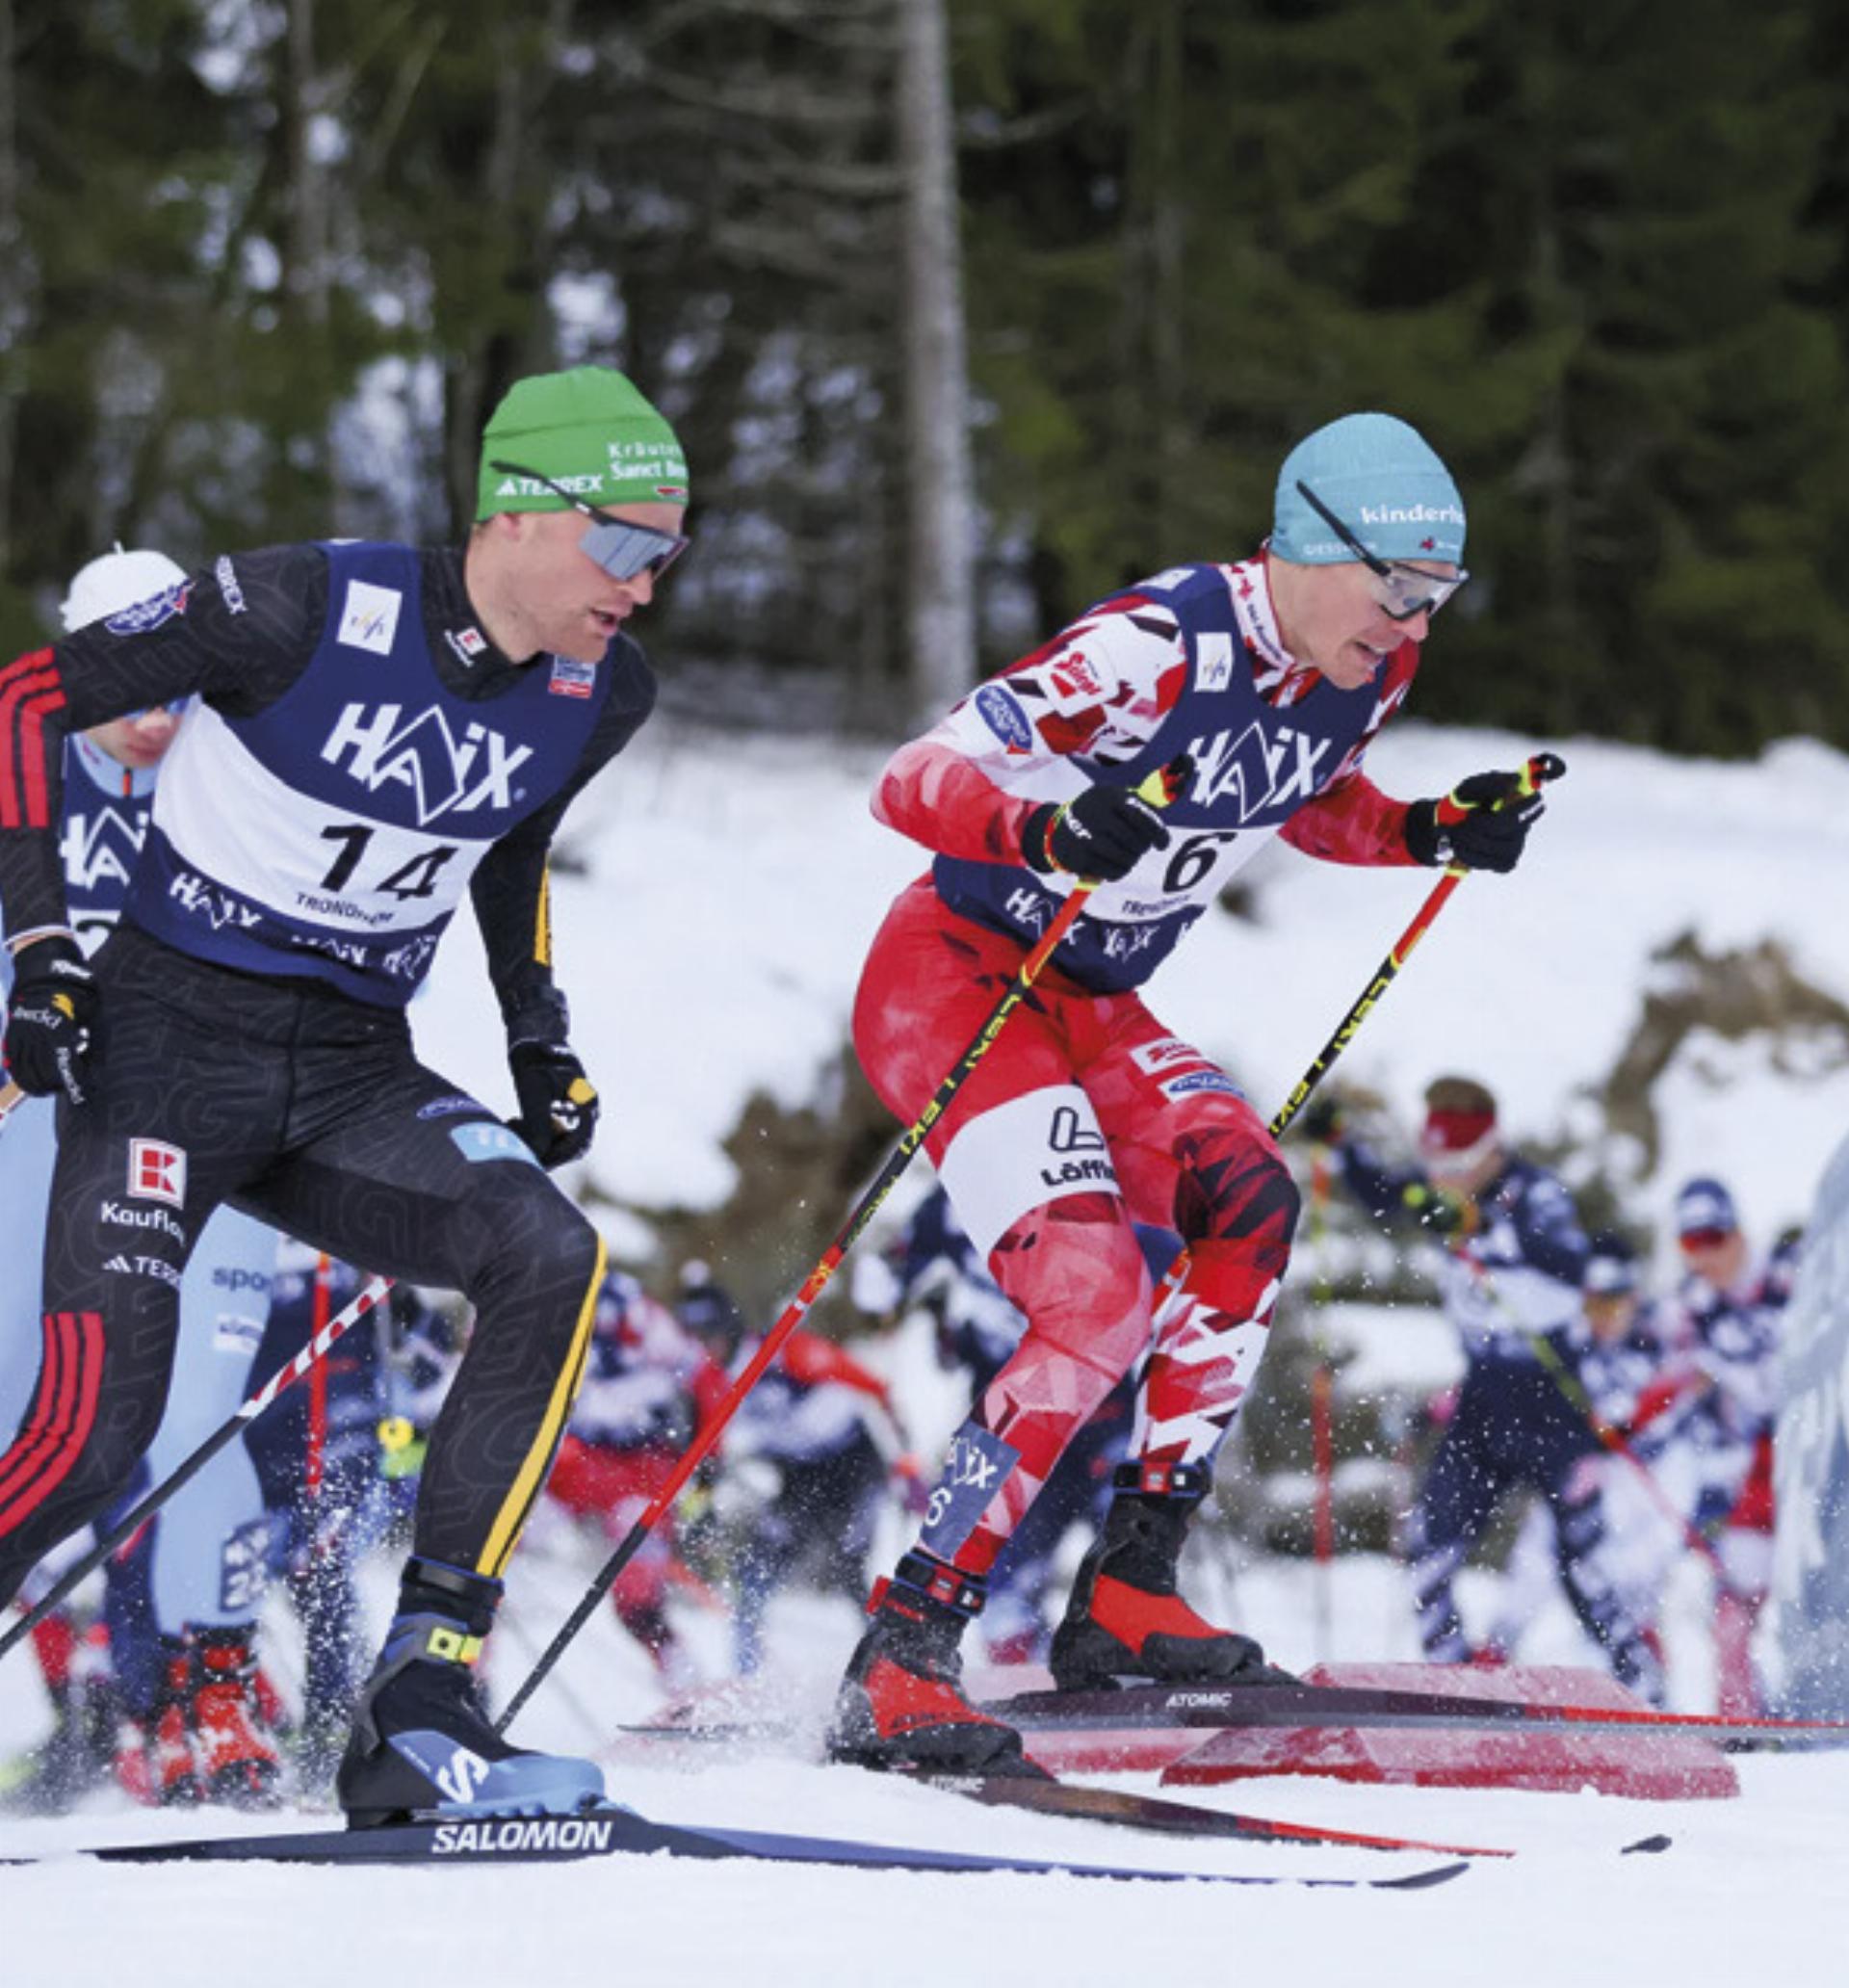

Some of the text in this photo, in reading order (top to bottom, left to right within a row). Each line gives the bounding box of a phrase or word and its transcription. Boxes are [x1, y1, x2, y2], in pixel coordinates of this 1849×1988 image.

[320, 824, 459, 911] 14
[1162, 833, 1238, 895] 6
[1165, 1691, 1234, 1709] ATOMIC
[430, 1820, 613, 1855] SALOMON
